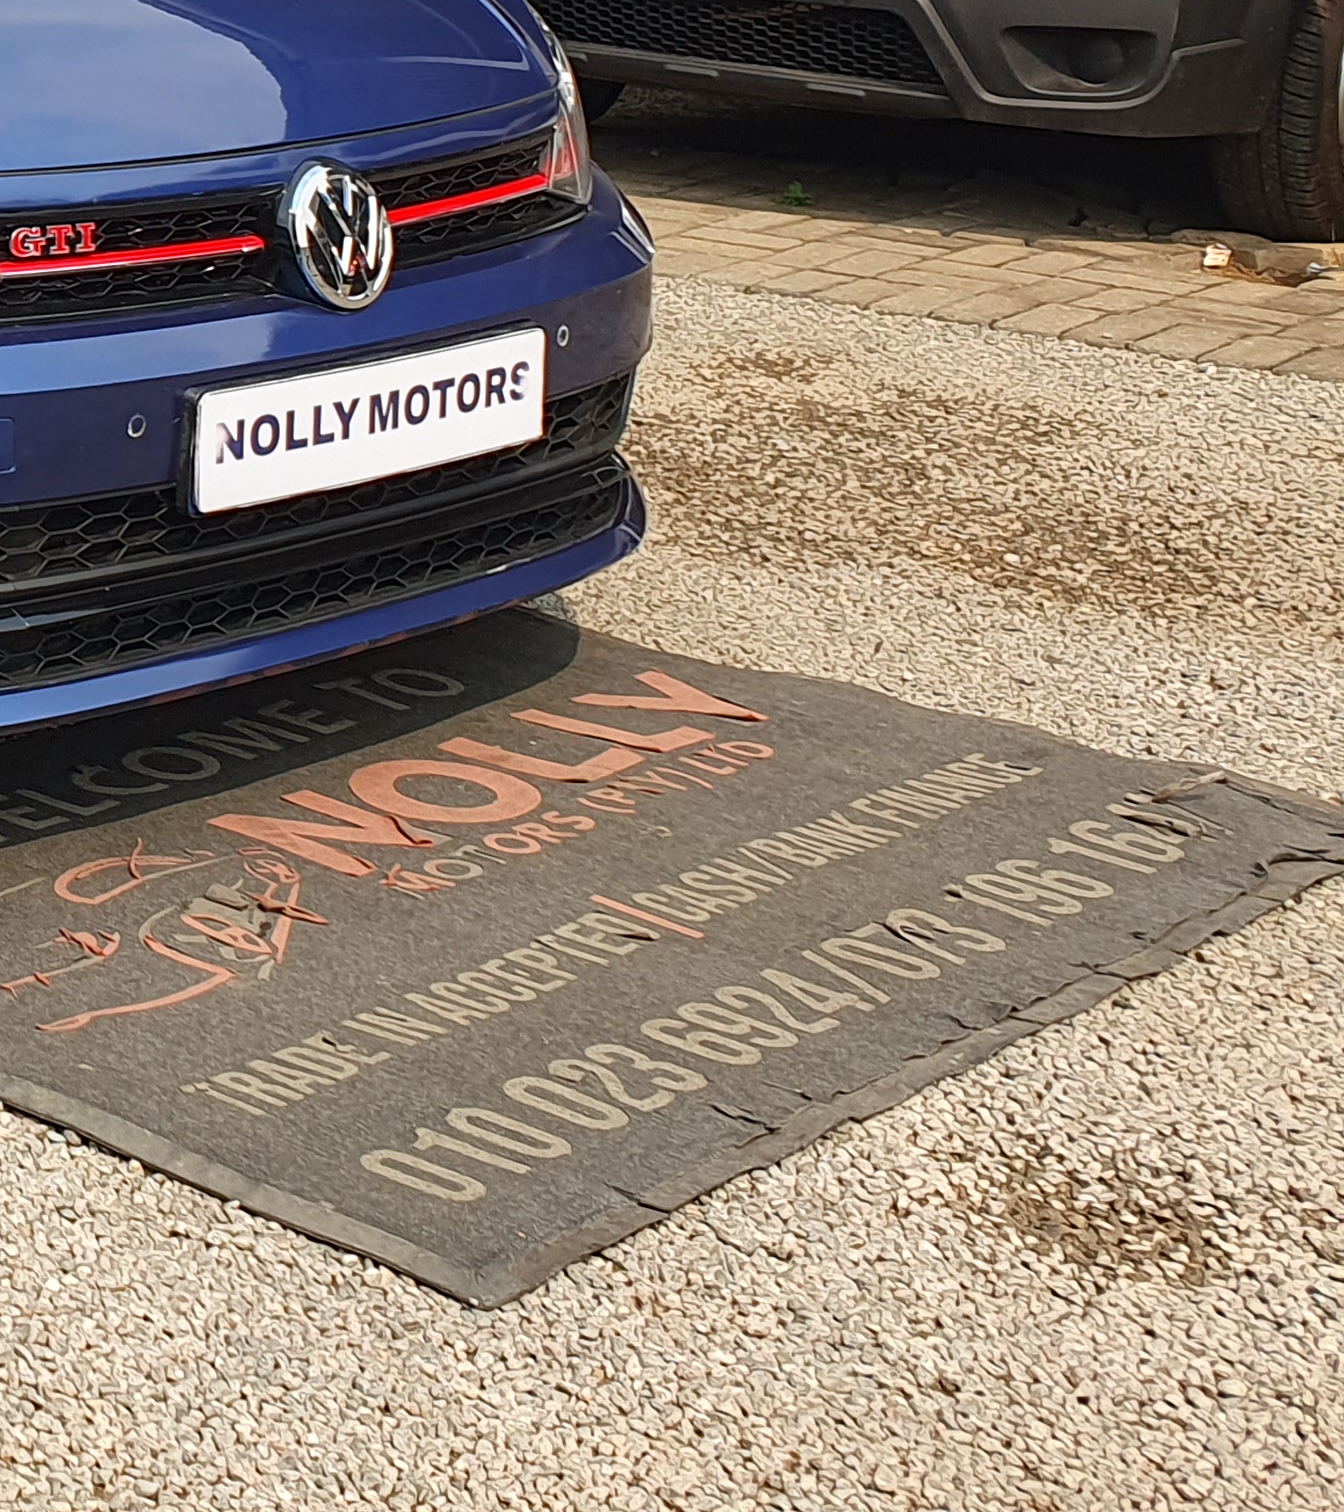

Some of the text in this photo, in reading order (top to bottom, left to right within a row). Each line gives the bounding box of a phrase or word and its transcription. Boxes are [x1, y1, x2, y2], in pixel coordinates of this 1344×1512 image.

[10, 221, 96, 258] GTI
[215, 360, 530, 465] NOLLY MOTORS
[312, 668, 465, 710] TO
[207, 667, 770, 877] NOLLY
[379, 810, 596, 899] MOTORS
[678, 740, 776, 775] LTD
[179, 1029, 391, 1115] TRADE
[342, 1006, 449, 1046] IN
[404, 909, 661, 1026] ACCEPTED
[850, 752, 1045, 829] FINANCE
[358, 1106, 573, 1202] 010
[502, 1042, 710, 1131] 023
[942, 858, 1115, 926] 196
